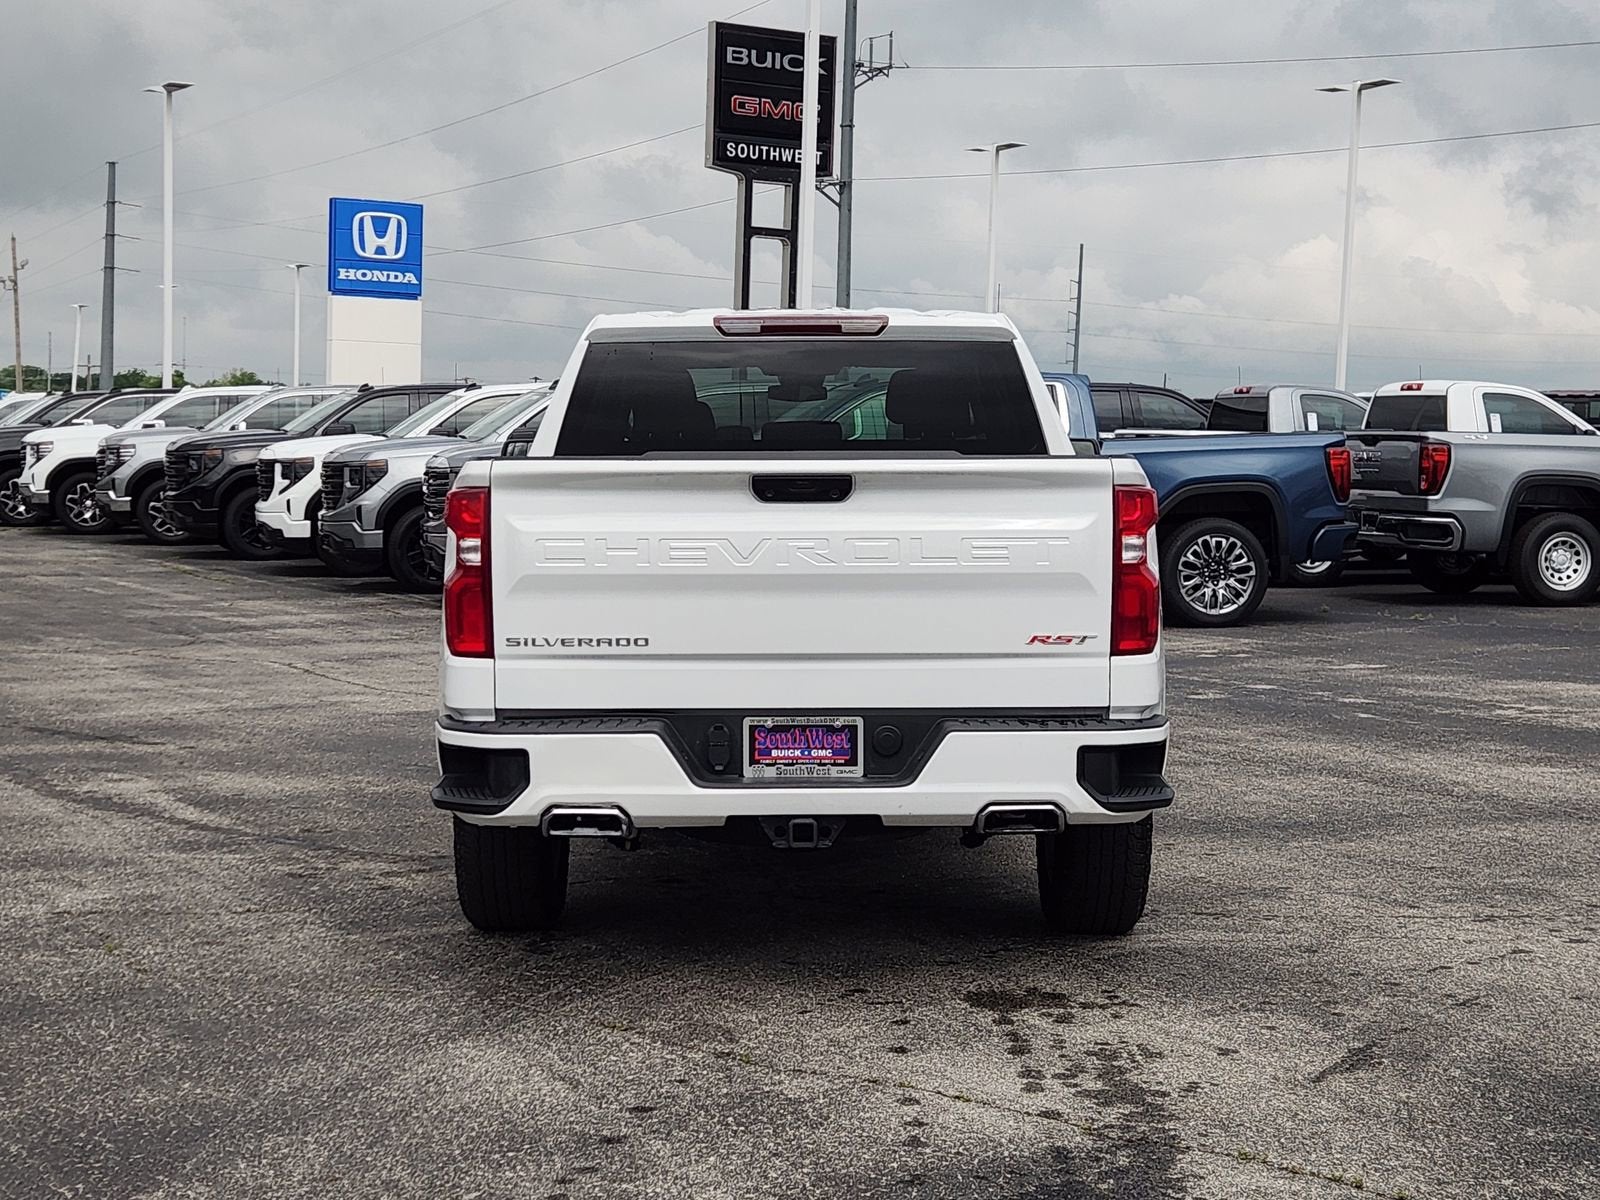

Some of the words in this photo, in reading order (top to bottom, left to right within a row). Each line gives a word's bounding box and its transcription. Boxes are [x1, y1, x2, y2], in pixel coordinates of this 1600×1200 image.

[726, 142, 823, 165] SOUTHWET
[337, 268, 419, 284] HONDA
[534, 537, 1070, 567] CHEVROLET
[505, 637, 649, 647] SILVERADO
[1025, 635, 1098, 645] RST
[771, 749, 802, 757] BUICK
[811, 749, 833, 757] GMC
[776, 766, 832, 776] SouthWest
